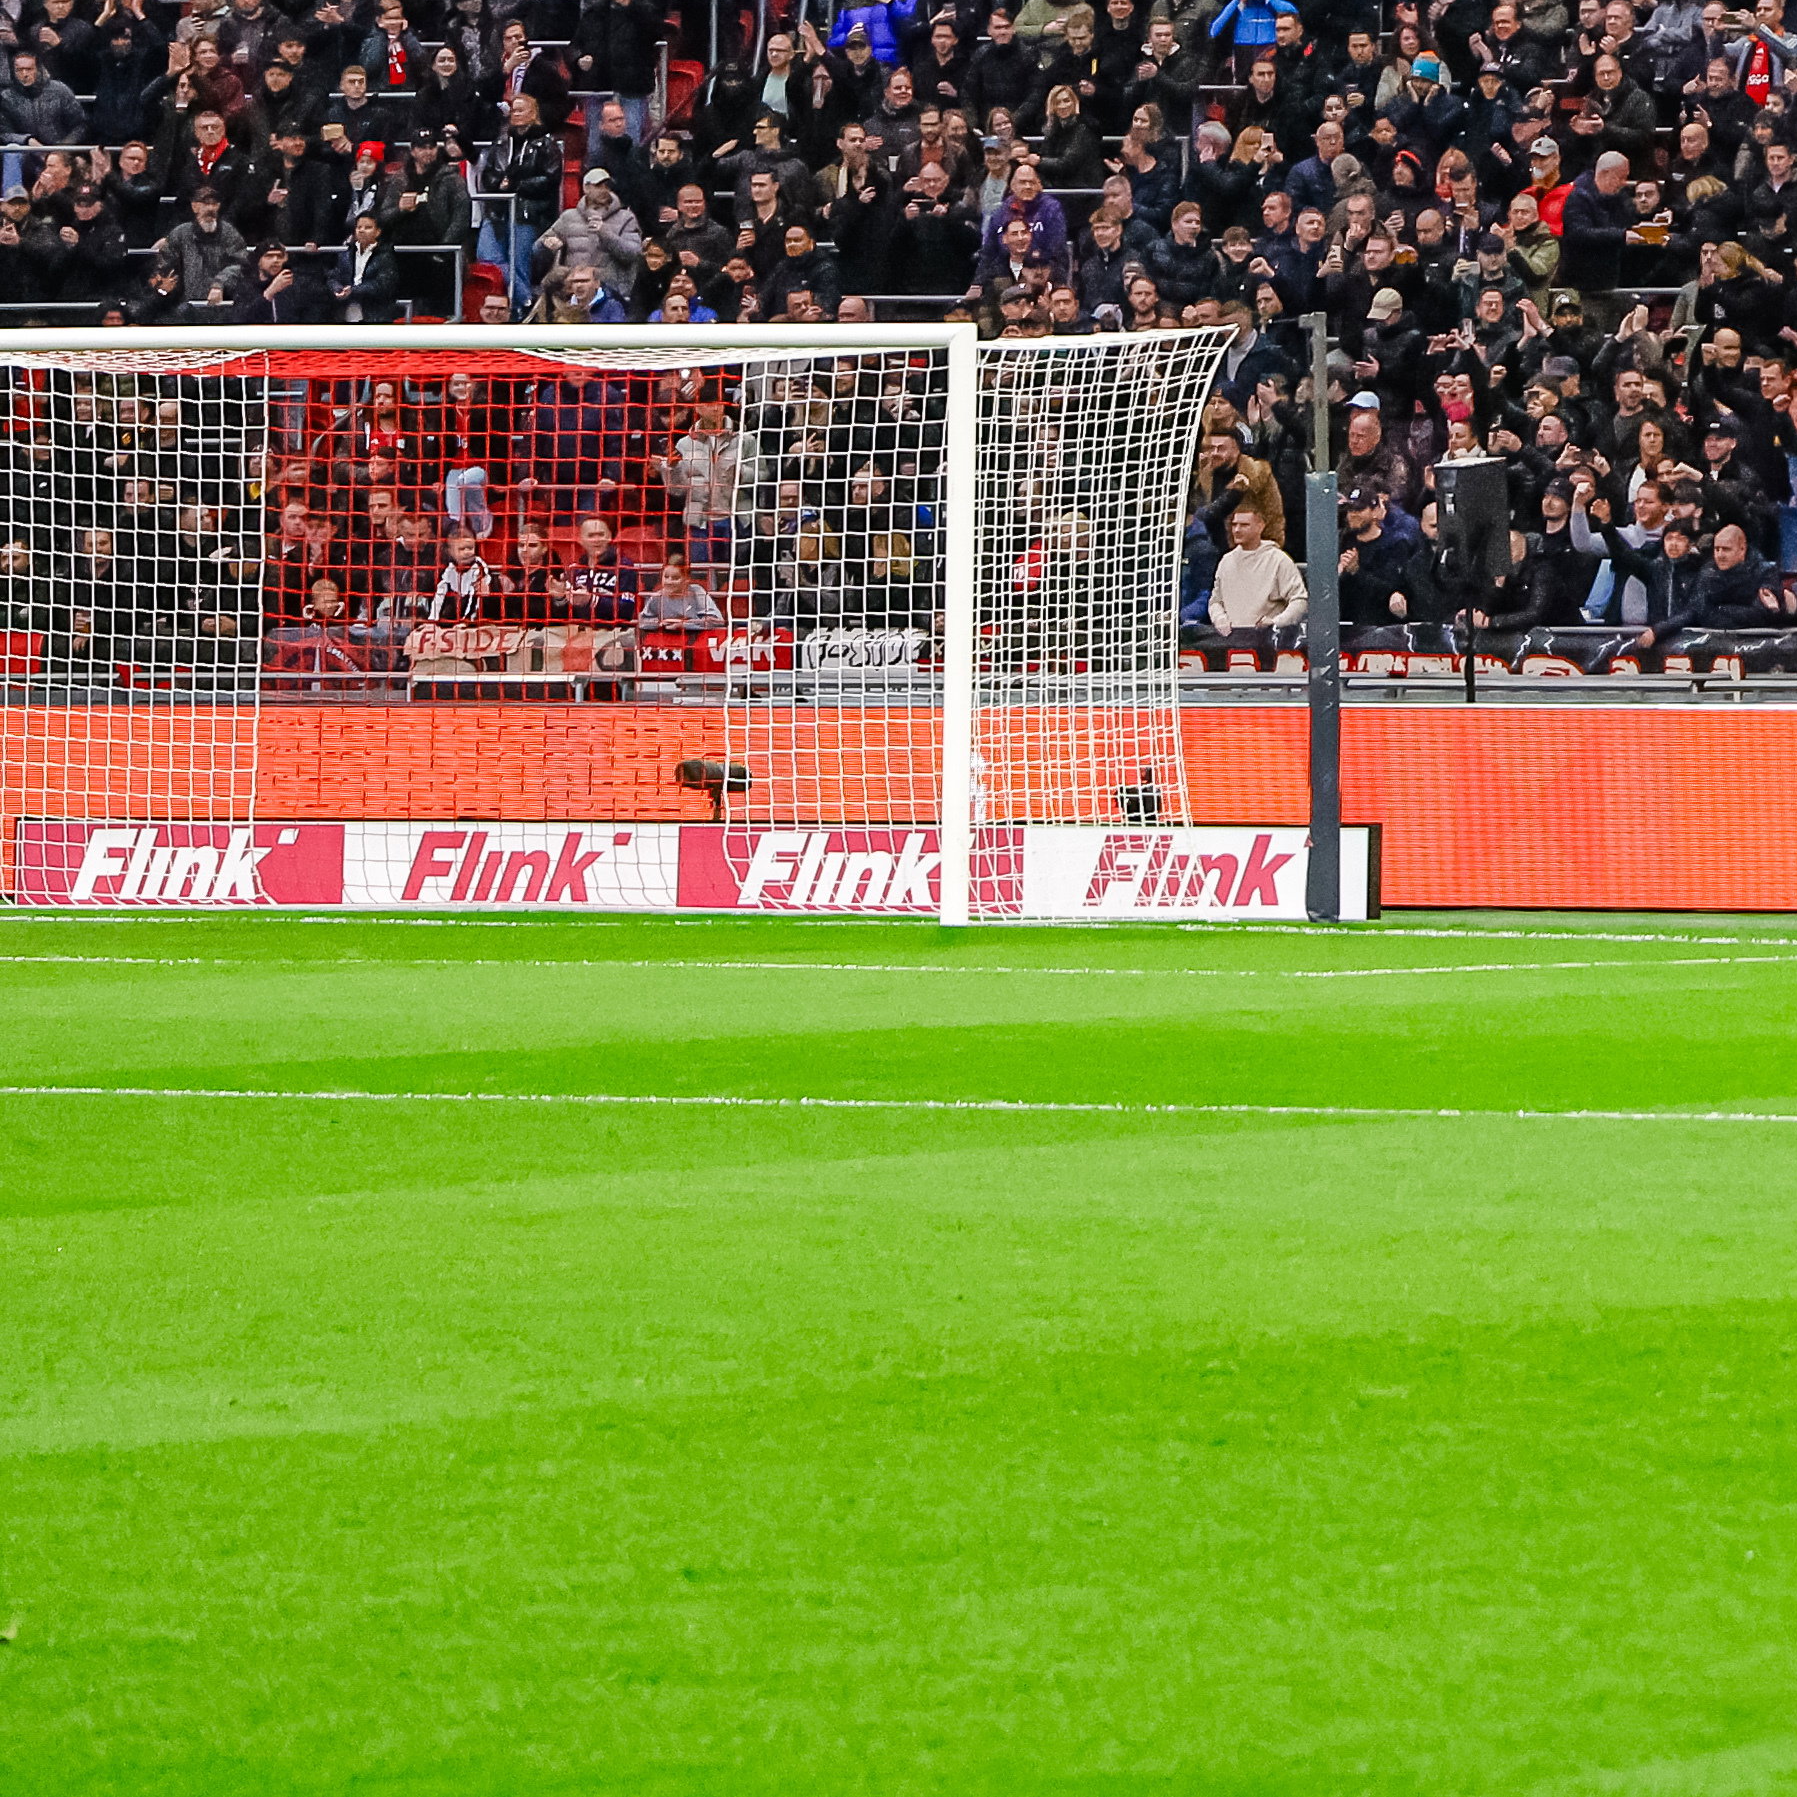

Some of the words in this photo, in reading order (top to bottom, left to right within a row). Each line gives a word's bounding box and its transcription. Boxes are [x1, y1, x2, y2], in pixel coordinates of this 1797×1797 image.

[71, 827, 273, 901] Flink
[401, 831, 605, 903] Flink
[737, 832, 942, 905] Flink
[1083, 834, 1296, 907] Flink
